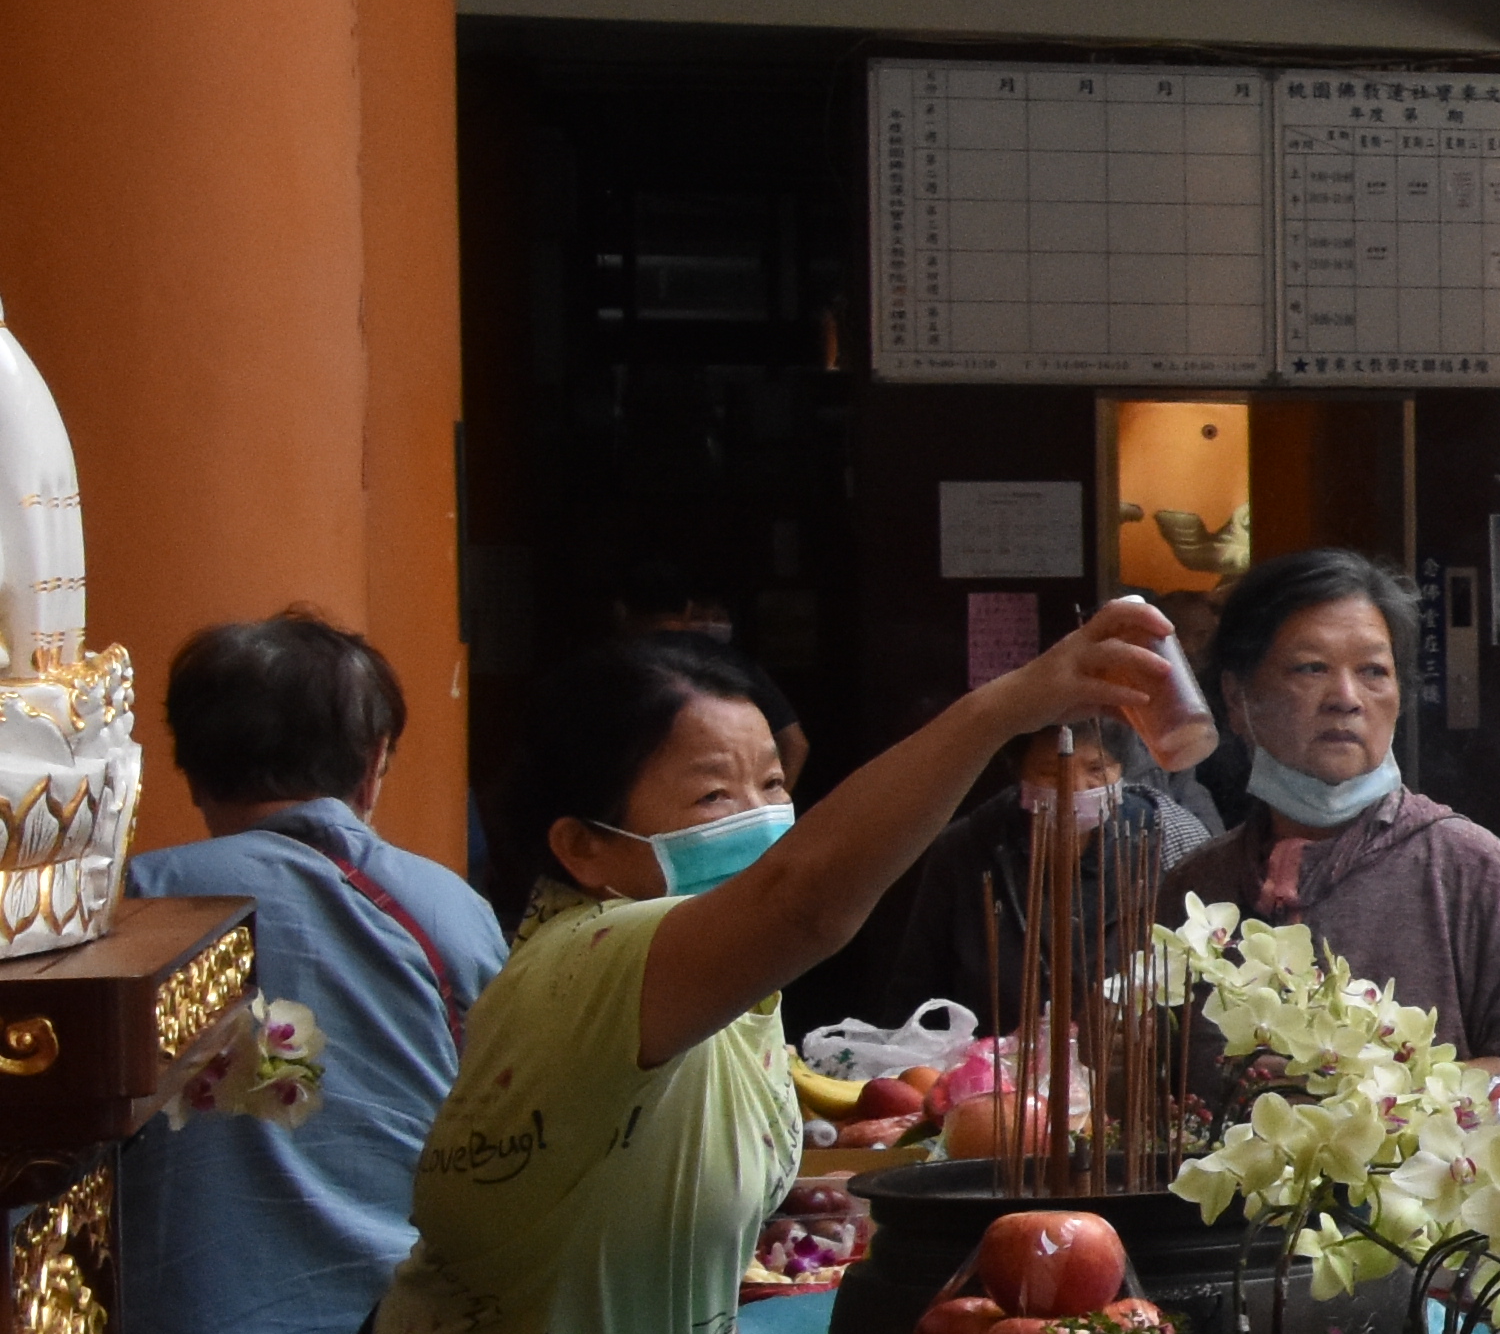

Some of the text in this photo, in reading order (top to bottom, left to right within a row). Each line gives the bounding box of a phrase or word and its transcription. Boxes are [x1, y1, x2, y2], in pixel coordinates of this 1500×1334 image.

[998, 78, 1015, 94] 月
[1078, 79, 1094, 94] 月
[1157, 80, 1173, 96] 月
[1235, 82, 1251, 98] 月
